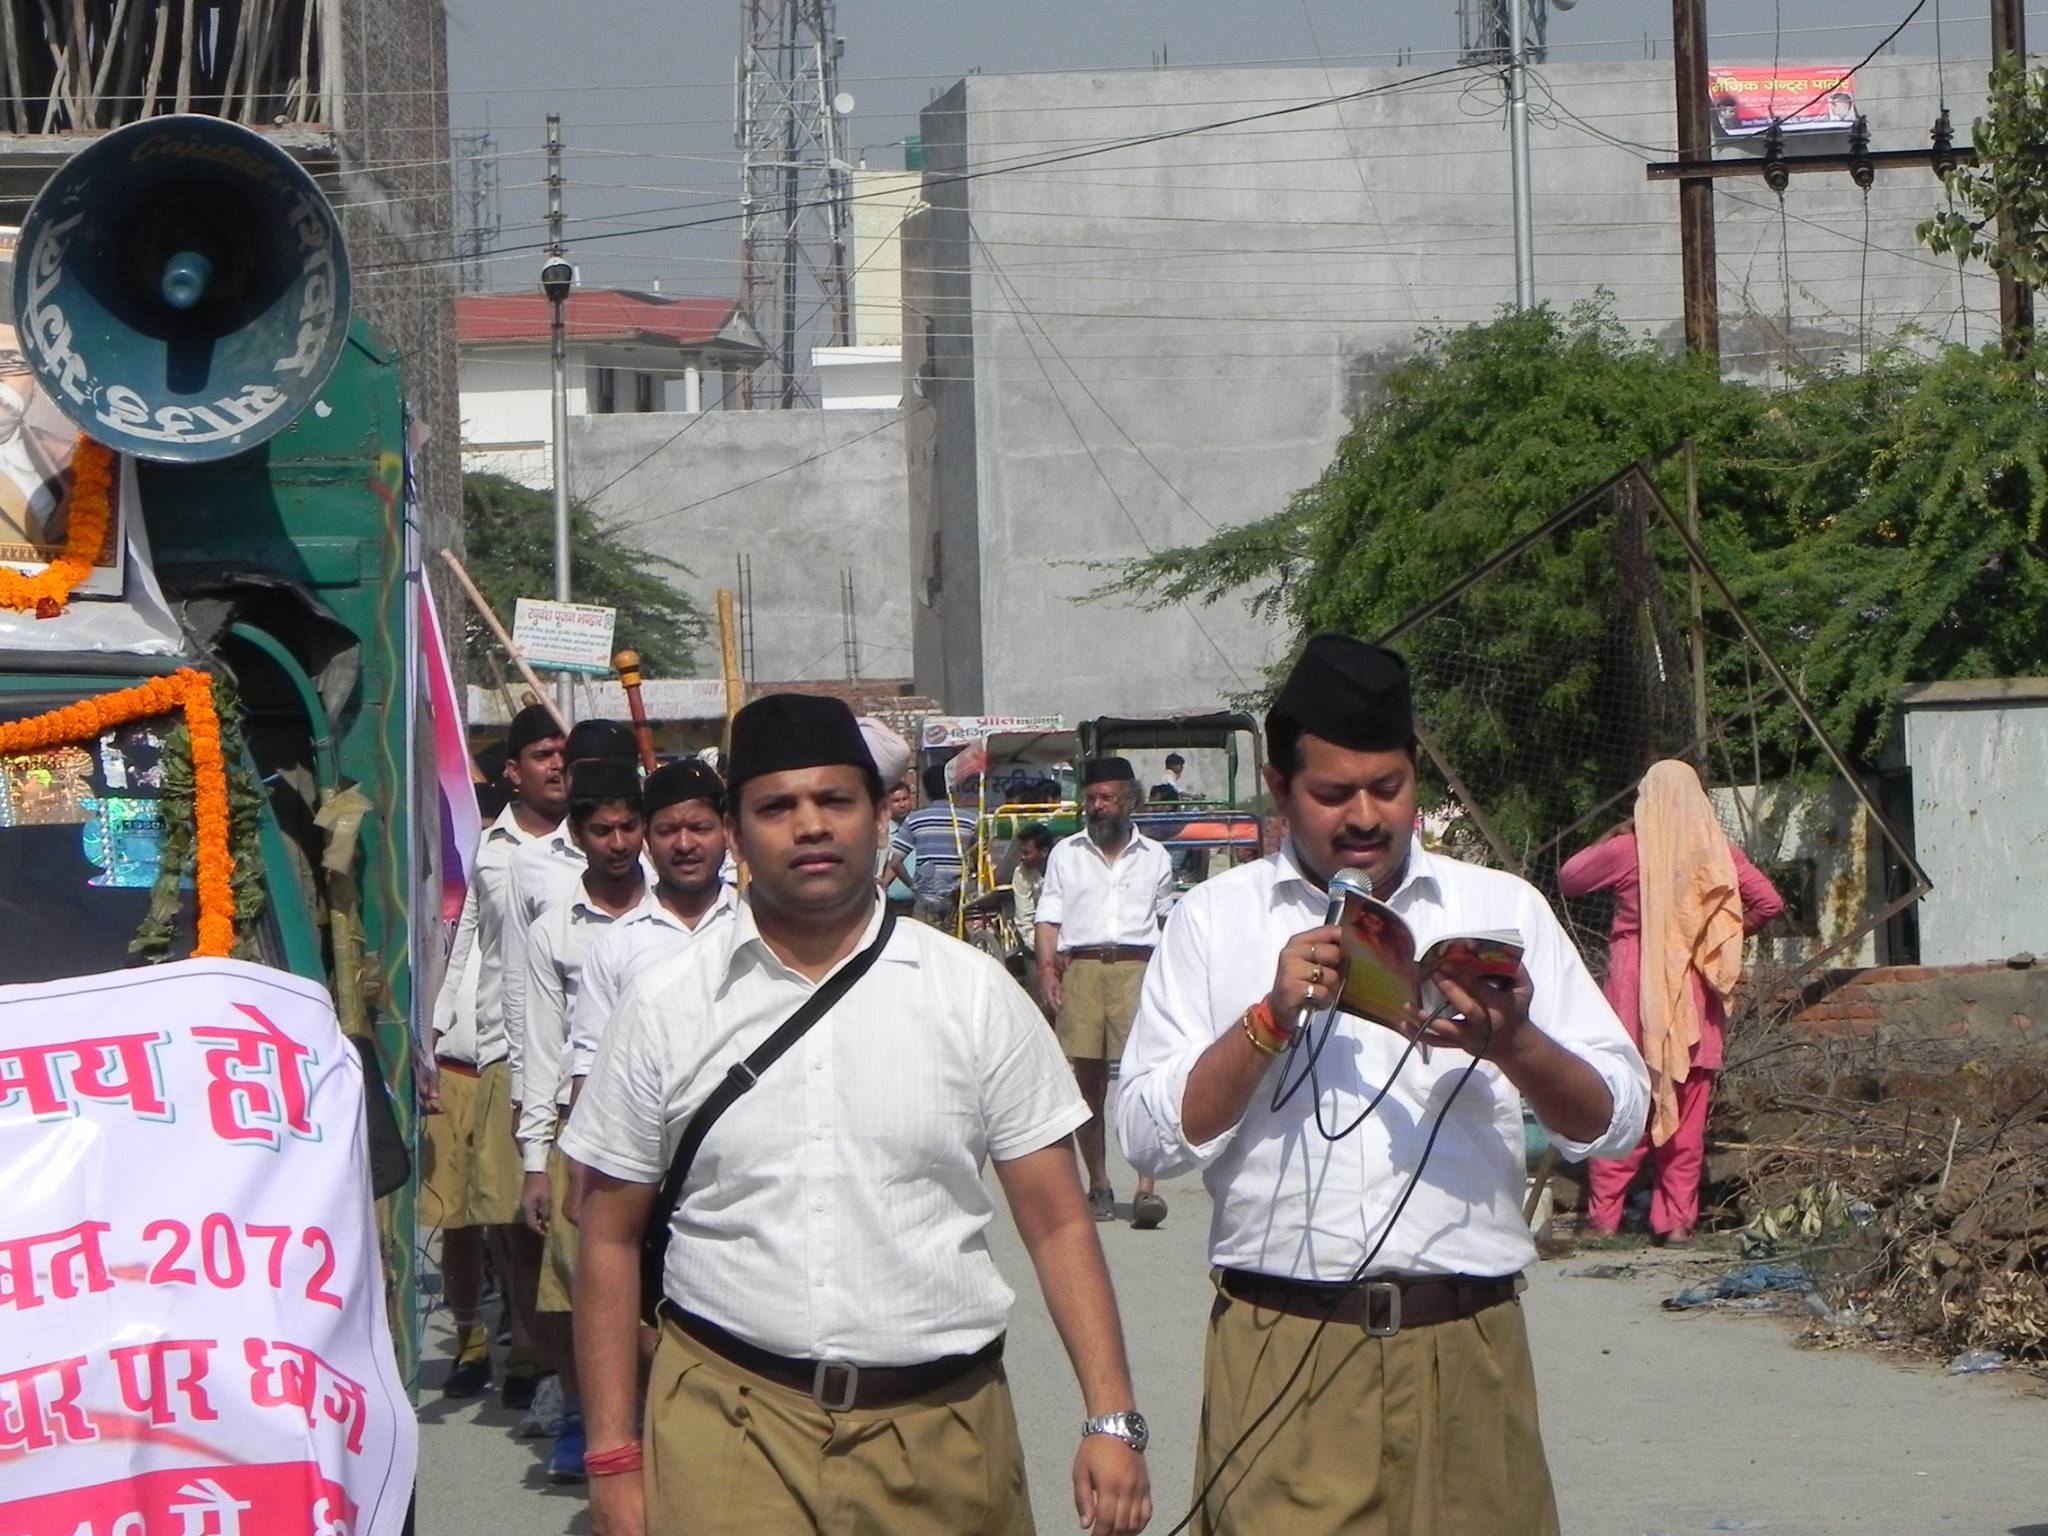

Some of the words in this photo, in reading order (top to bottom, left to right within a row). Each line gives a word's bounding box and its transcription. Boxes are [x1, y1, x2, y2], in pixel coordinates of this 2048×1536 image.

[191, 1002, 318, 1148] हो
[141, 1212, 344, 1311] 2072
[109, 1338, 219, 1426] पर
